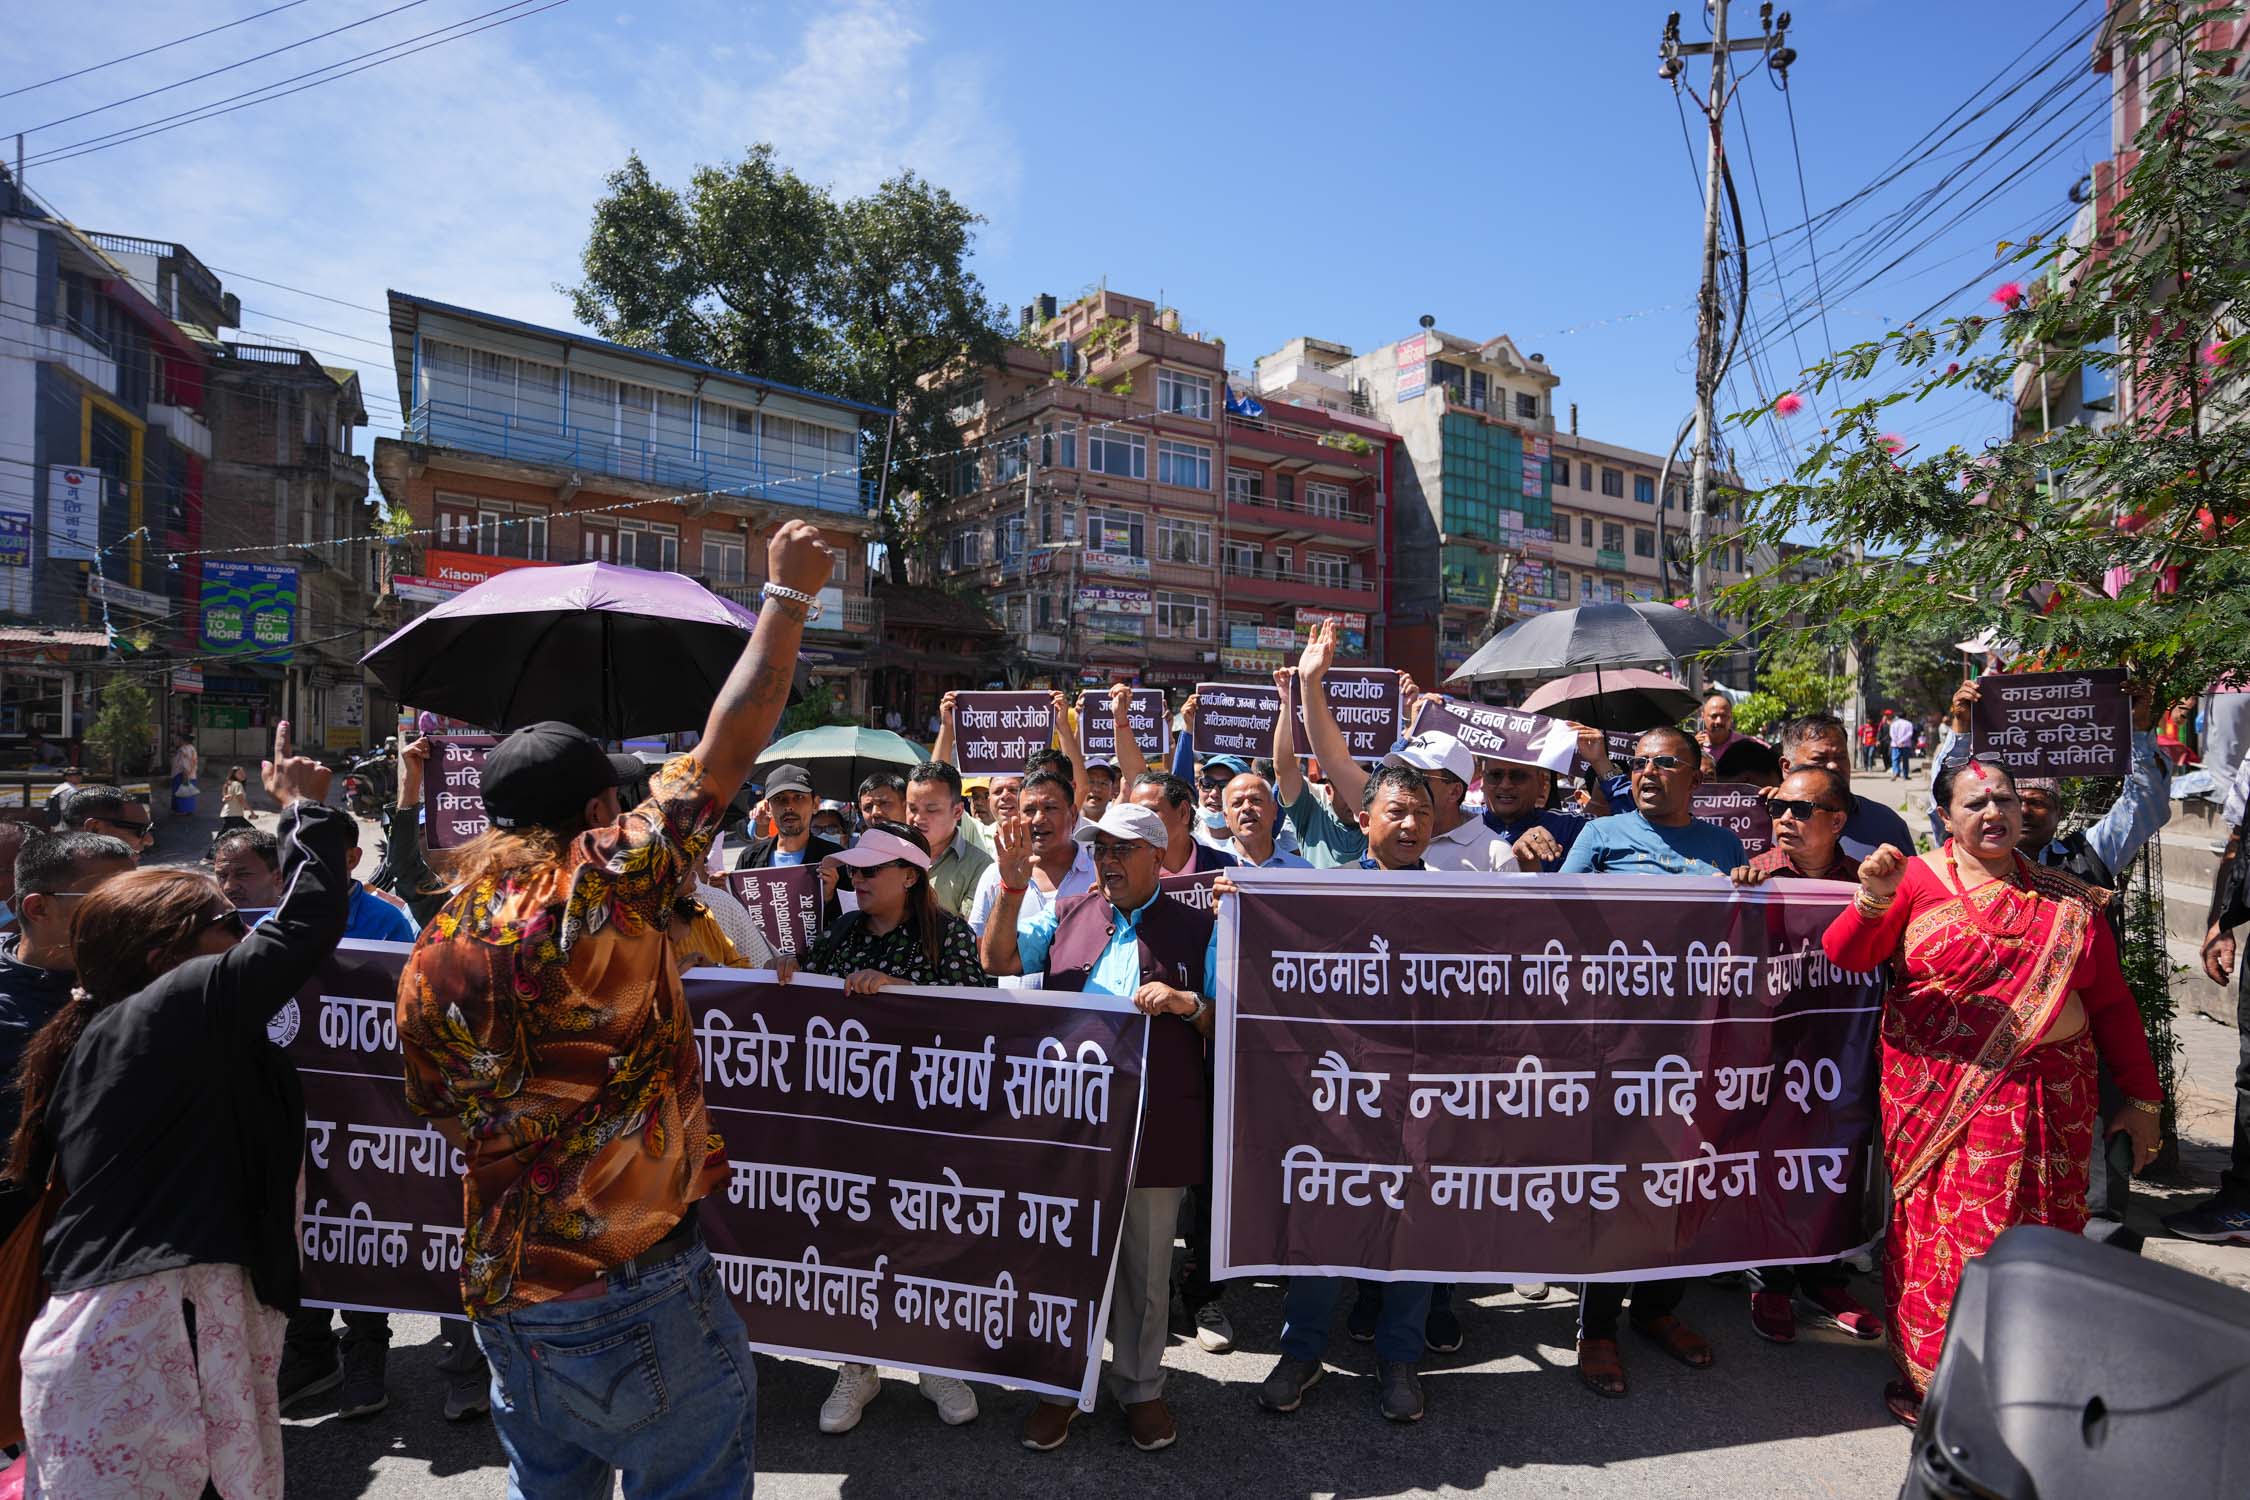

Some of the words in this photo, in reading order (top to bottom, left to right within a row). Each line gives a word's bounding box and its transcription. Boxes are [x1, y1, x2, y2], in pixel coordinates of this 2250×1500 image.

[204, 561, 224, 570] THELA
[1087, 553, 1114, 564] BCC
[253, 565, 272, 573] THELA
[438, 567, 488, 582] Xiaomi
[207, 610, 240, 620] OPEN
[208, 620, 225, 629] TO
[255, 612, 287, 623] OPEN
[207, 630, 242, 640] MORE
[256, 622, 273, 631] TO
[255, 632, 288, 642] MORE
[1330, 677, 1384, 699] न्यायीक
[961, 705, 997, 729] फैसला
[1000, 705, 1050, 728] खारेजीको
[1336, 706, 1392, 725] मापदण्ड
[2006, 705, 2096, 723] उपत्यका
[1509, 715, 1536, 734] गर्न
[1354, 731, 1376, 750] गर
[1988, 726, 2029, 748] नदि
[2036, 722, 2115, 744] करिडोर
[445, 743, 475, 762] गैर
[966, 736, 998, 759] आदेश
[1001, 736, 1026, 759] जारी
[2047, 745, 2116, 765] समिति
[445, 767, 482, 789] नदि
[1693, 791, 1759, 808] न्यायीक
[1730, 817, 1750, 832] २०
[1272, 934, 1390, 995] काठमाडौं
[1400, 953, 1512, 998] उपत्यका
[1520, 939, 1572, 1006] नदि
[1581, 939, 1677, 997] करिडोर
[1686, 940, 1757, 997] पिडित
[1767, 938, 1808, 997] संघर्ष
[693, 1009, 795, 1093] रिडोर
[805, 1016, 901, 1104] पिडित
[910, 1034, 995, 1111] संघर्ष
[1003, 1036, 1114, 1125] समिति
[1311, 1050, 1390, 1118] गैर
[1408, 1055, 1596, 1120] न्यायीक
[1611, 1054, 1703, 1126] नदि
[1714, 1064, 1775, 1111] थप
[1784, 1057, 1842, 1114] २०
[1281, 1144, 1413, 1210] मिटर
[1430, 1163, 1627, 1223] मापदण्ड
[1642, 1141, 1759, 1208] खारेज
[1774, 1148, 1848, 1194] गर
[728, 1160, 876, 1227] मापदण्ड
[889, 1167, 1005, 1237] खारेज
[1018, 1192, 1078, 1248] गर
[894, 1270, 1018, 1350] कारवाही
[1028, 1292, 1077, 1348] गर
